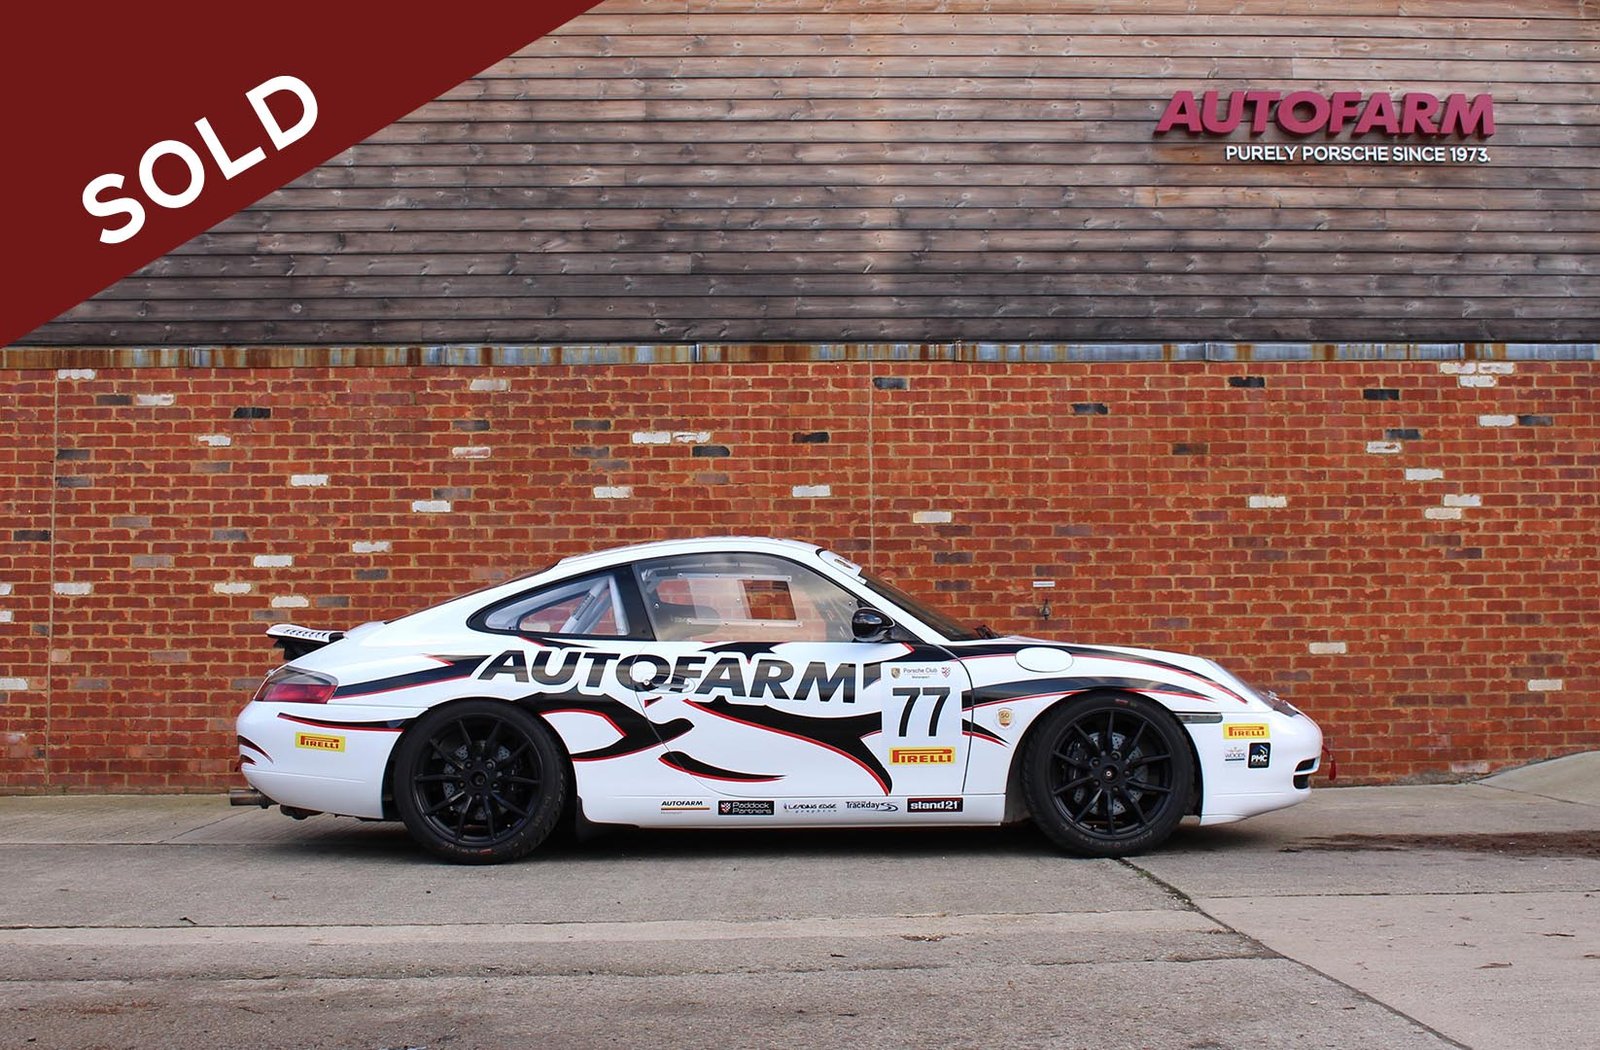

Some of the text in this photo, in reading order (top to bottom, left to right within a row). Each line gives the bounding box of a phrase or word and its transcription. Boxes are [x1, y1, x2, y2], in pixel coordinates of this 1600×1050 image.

[1154, 91, 1495, 137] AUTOFARM
[1226, 145, 1491, 163] PURELY PORSCHE SINCE 1973.
[478, 650, 857, 704] AUTOFARM
[892, 687, 950, 737] 77
[1228, 726, 1265, 736] PIRELLI
[300, 735, 340, 749] PIRELLI
[892, 749, 953, 763] PIRELLI
[910, 801, 958, 809] stand21
